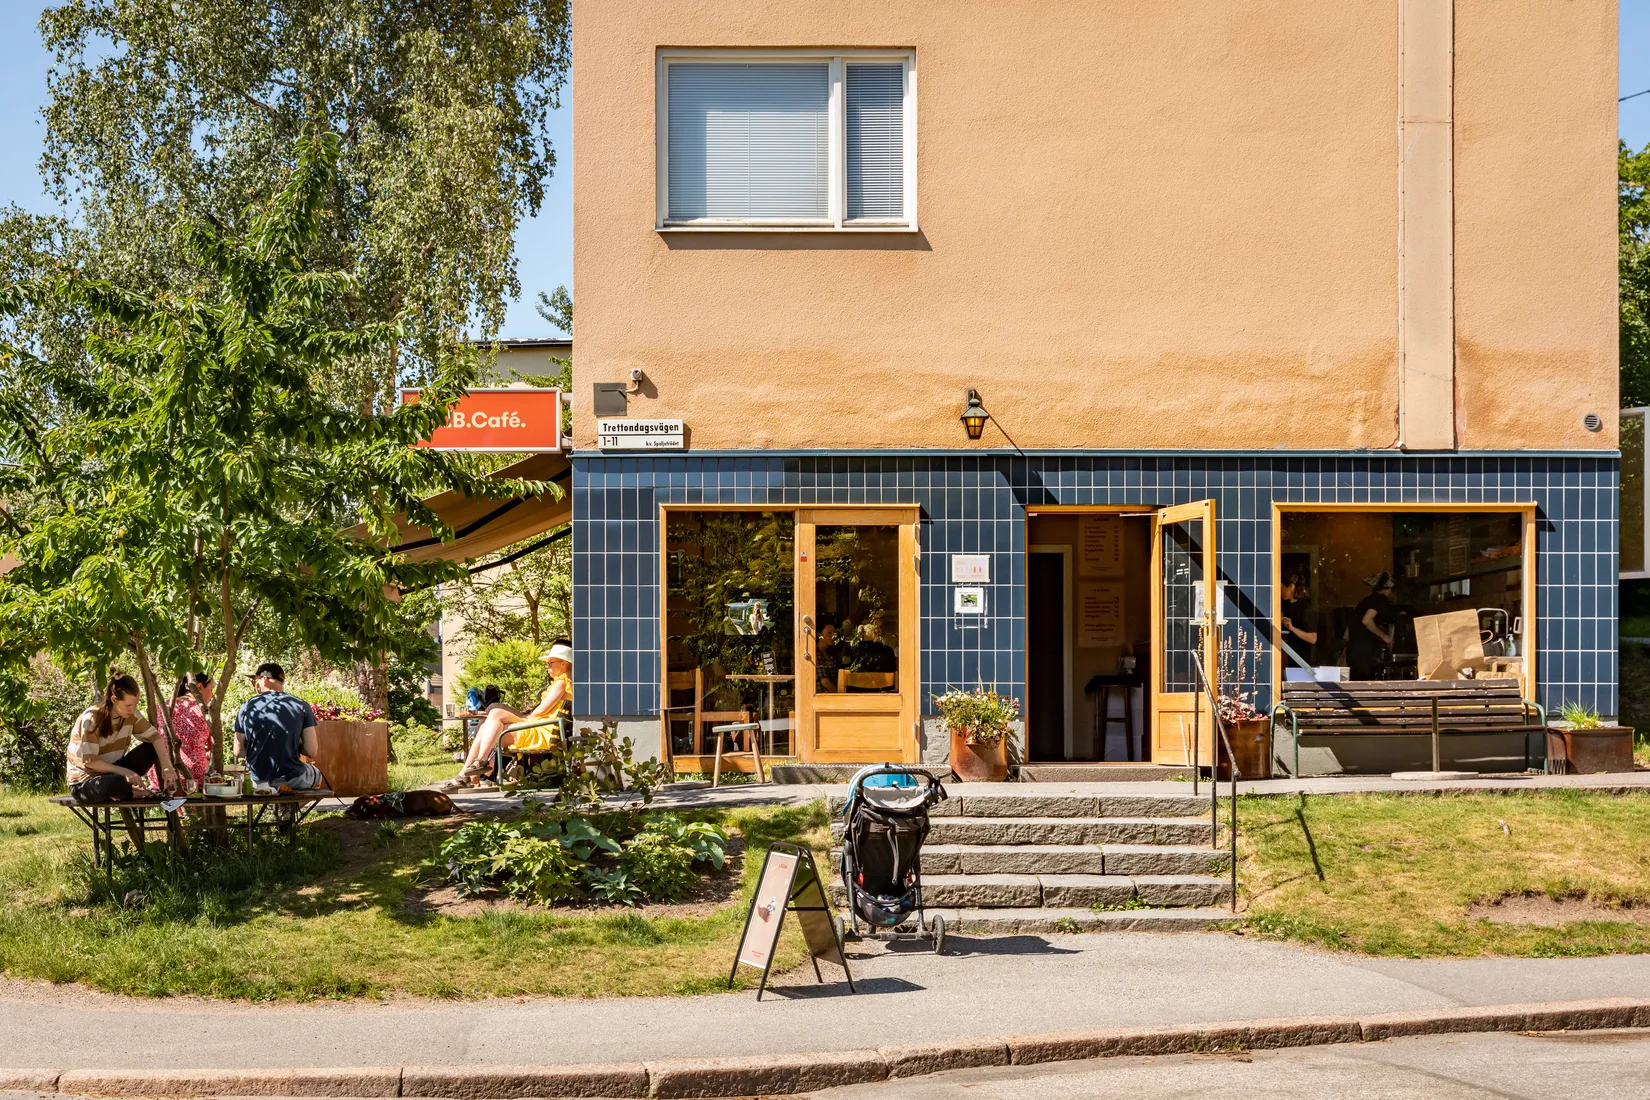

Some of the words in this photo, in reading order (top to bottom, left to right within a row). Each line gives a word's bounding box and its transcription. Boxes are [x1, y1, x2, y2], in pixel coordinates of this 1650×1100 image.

[444, 411, 527, 429] .B.Café.
[602, 422, 679, 433] Trettondagsvägen
[602, 436, 618, 446] 1-11
